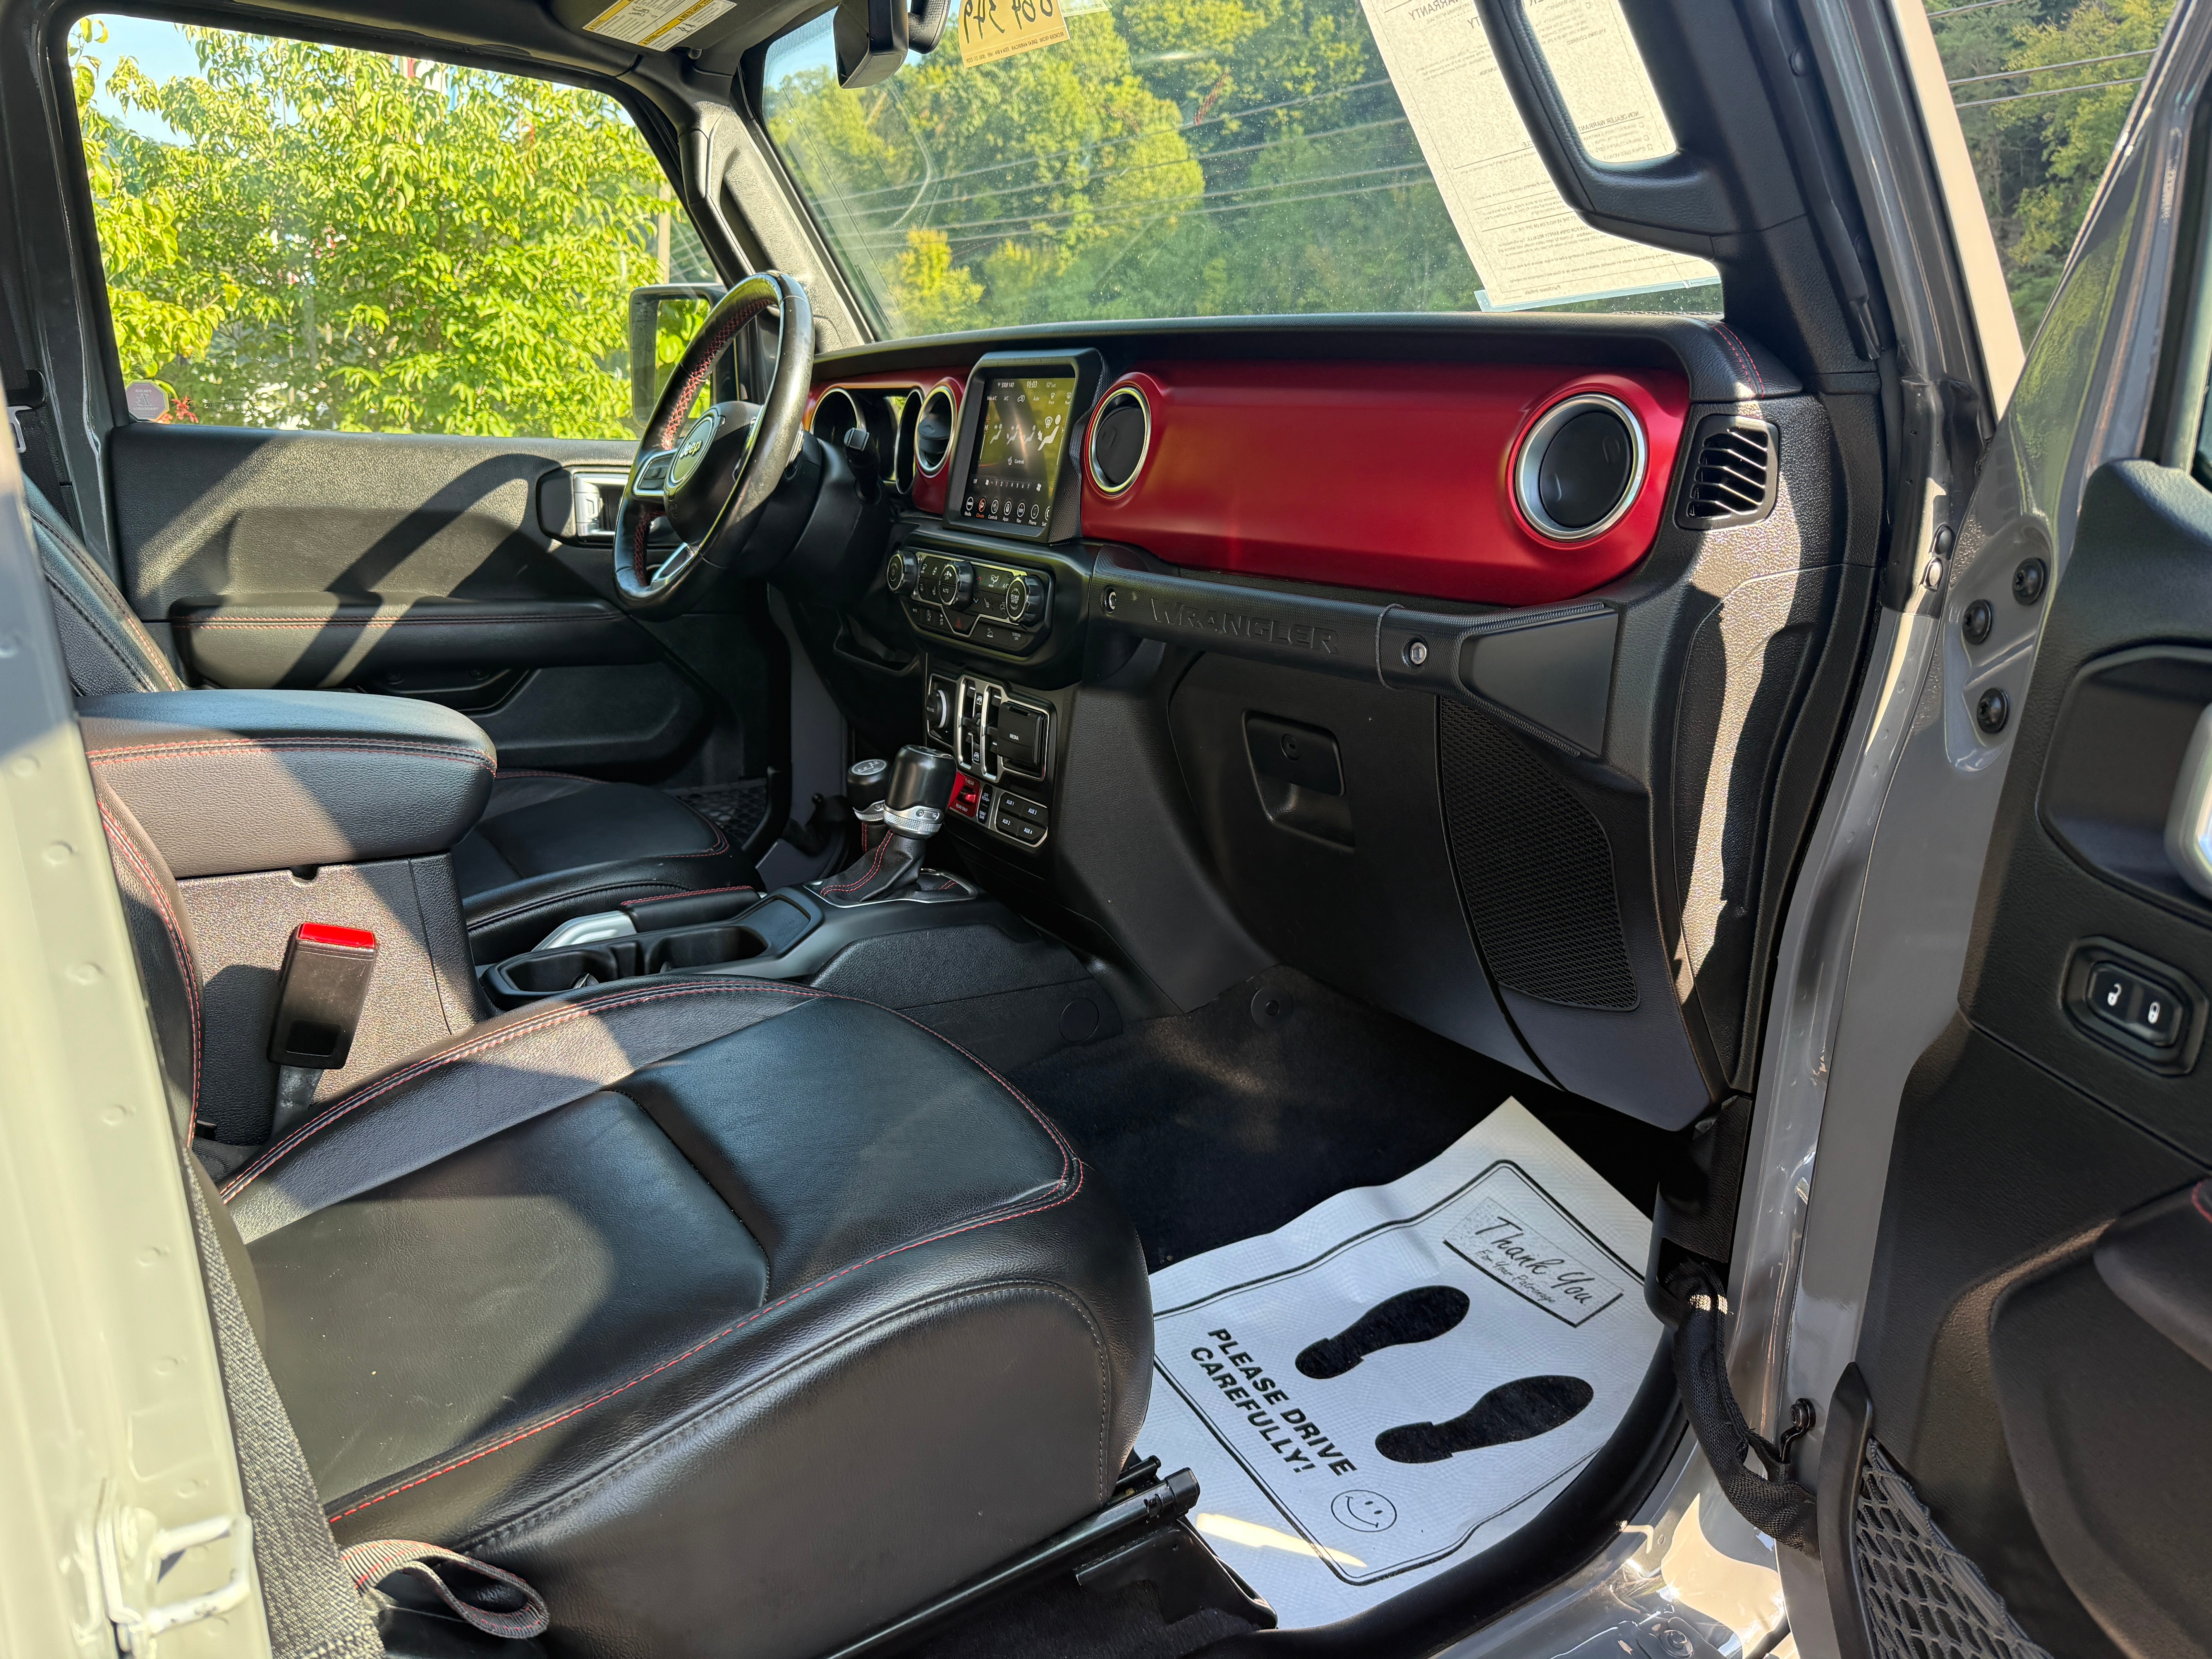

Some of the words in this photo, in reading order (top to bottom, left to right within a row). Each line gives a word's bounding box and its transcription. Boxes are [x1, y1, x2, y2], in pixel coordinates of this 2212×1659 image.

[680, 440, 703, 459] Jeep
[1150, 598, 1339, 654] WRANGLER
[1475, 1216, 1565, 1274] Thank
[1550, 1272, 1595, 1304] You
[1475, 1249, 1493, 1264] For
[1493, 1260, 1513, 1276] Your
[1511, 1274, 1556, 1304] Patronage
[1191, 1347, 1317, 1473] CAREFULLY!
[1207, 1328, 1290, 1405] PLEASE
[1279, 1408, 1358, 1476] DRIVE
